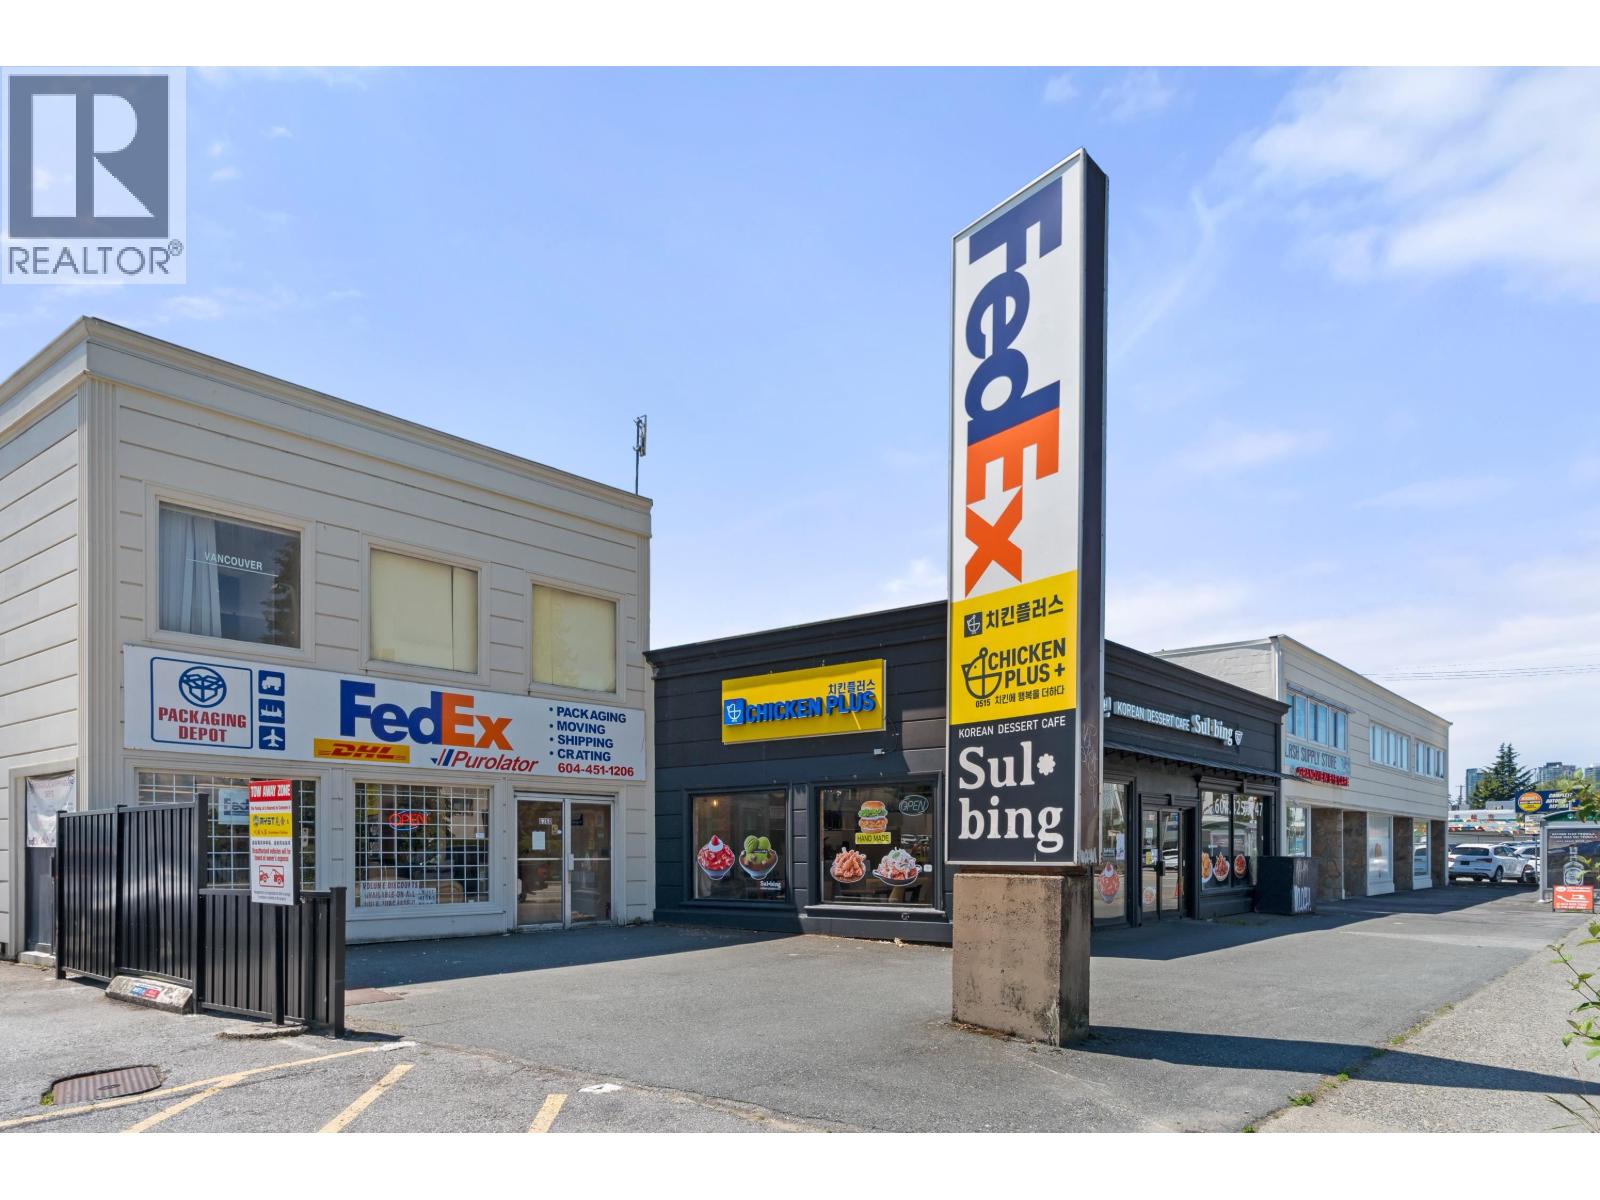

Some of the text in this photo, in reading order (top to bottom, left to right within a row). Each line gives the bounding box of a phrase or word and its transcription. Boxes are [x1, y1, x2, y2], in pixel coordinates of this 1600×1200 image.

[964, 175, 1063, 599] FedEx
[204, 551, 263, 571] VANCOUVER
[986, 594, 1064, 629] 치킨플러스
[988, 637, 1066, 671] CHICKEN
[828, 679, 876, 695] 치킨플러스
[995, 692, 1016, 705] 치킨에
[1041, 685, 1065, 698] 더하다
[745, 691, 876, 723] CHICKEN PLUS
[975, 698, 991, 708] 0515
[158, 707, 247, 728] PACKAGING
[340, 679, 514, 751] FedEx
[557, 706, 627, 724] PACKAGING
[1116, 701, 1145, 720] KOREAN
[1146, 709, 1175, 727] DESSERT
[1175, 716, 1191, 732] CAFE
[178, 725, 227, 742] DEPOT
[557, 720, 606, 735] MOVING
[958, 715, 1066, 739] KOREAN DESSERT CAFE
[557, 734, 614, 749] SHIPPING
[329, 742, 396, 761] DHL
[450, 750, 539, 772] Purolator
[557, 748, 611, 763] CRATING
[1300, 747, 1321, 765] SUPPLY
[1321, 753, 1337, 769] STORE
[557, 762, 634, 778] 604-451-1206
[958, 740, 1035, 790] Sul
[250, 783, 291, 797] TOW AWAY ZONE
[224, 798, 249, 816] Fed
[901, 798, 926, 812] OPEN
[388, 812, 428, 826] OPEN
[958, 795, 1064, 853] bing
[857, 833, 889, 842] HAND MADE
